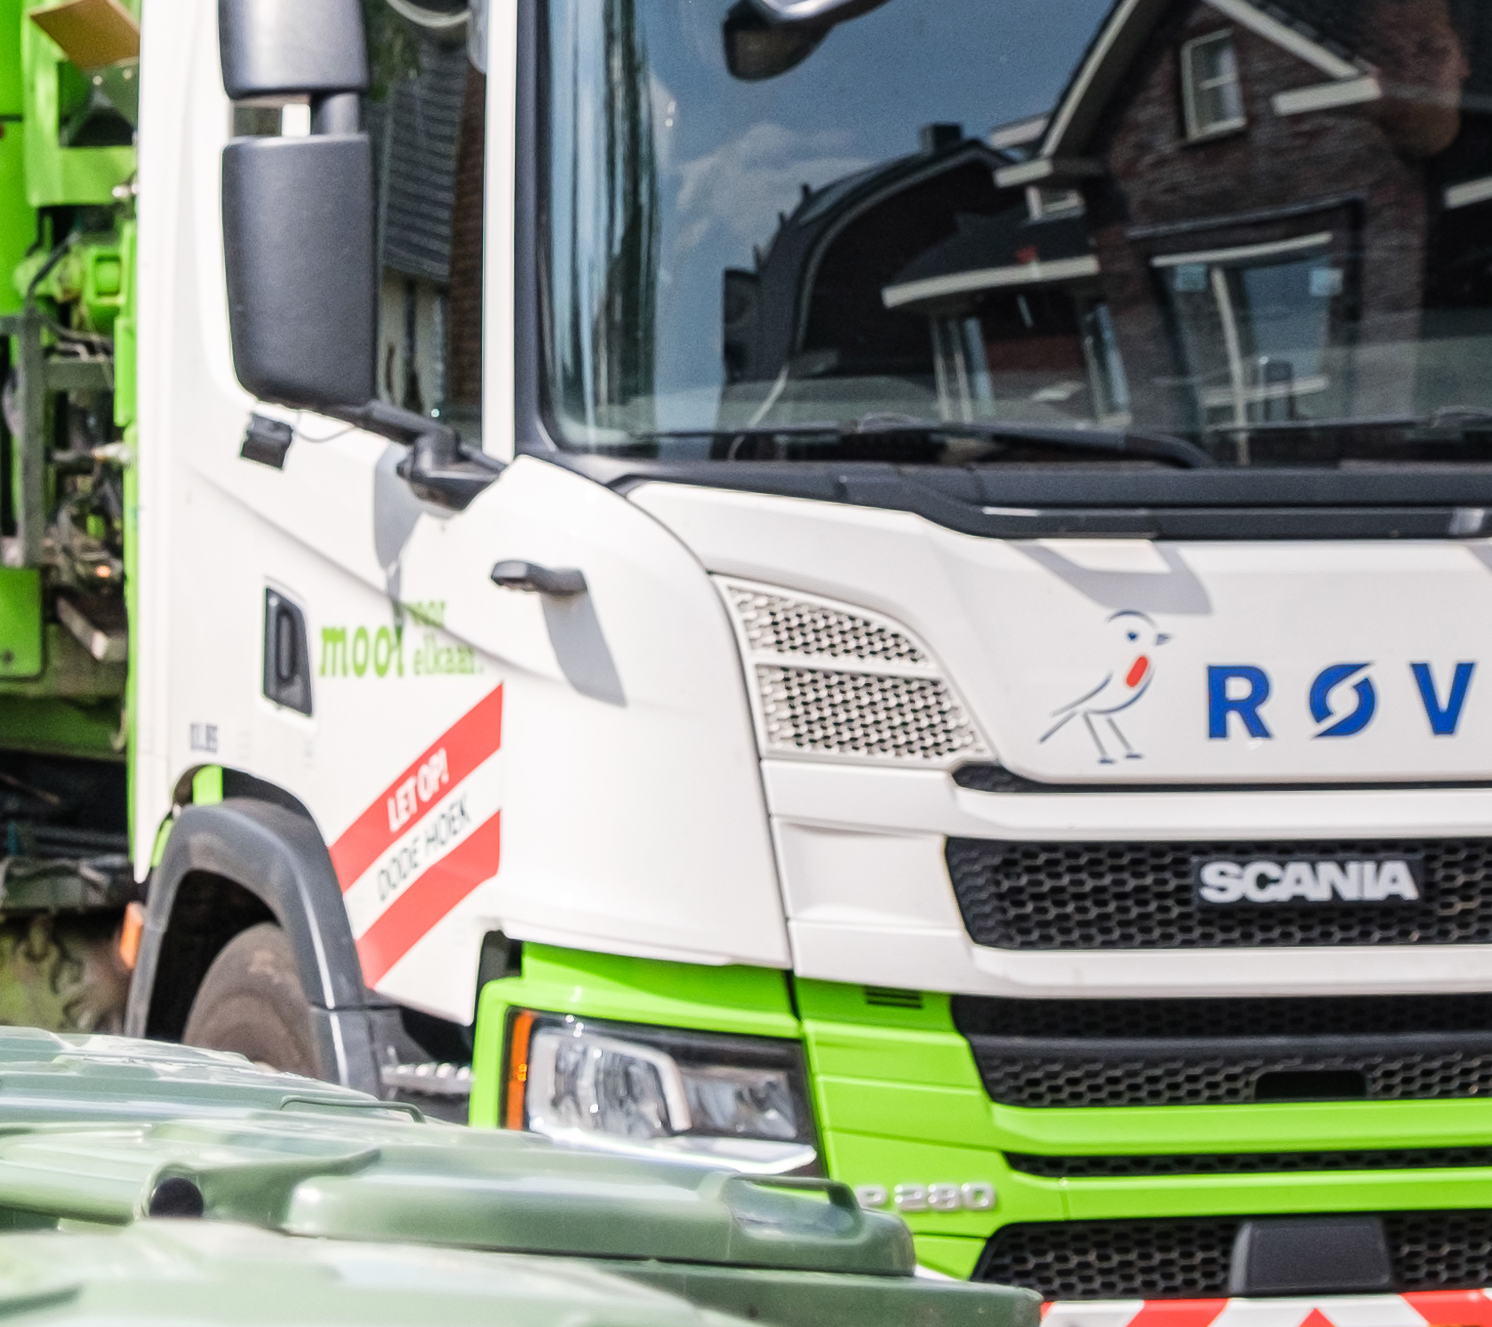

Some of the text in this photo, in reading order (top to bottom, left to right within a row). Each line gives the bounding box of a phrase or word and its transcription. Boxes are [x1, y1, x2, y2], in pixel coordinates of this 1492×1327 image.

[320, 598, 404, 677] mooi
[387, 746, 449, 833] LET OP!
[377, 790, 472, 902] DODE HOEK
[1199, 860, 1419, 904] SCANIA
[894, 1181, 996, 1213] 280
